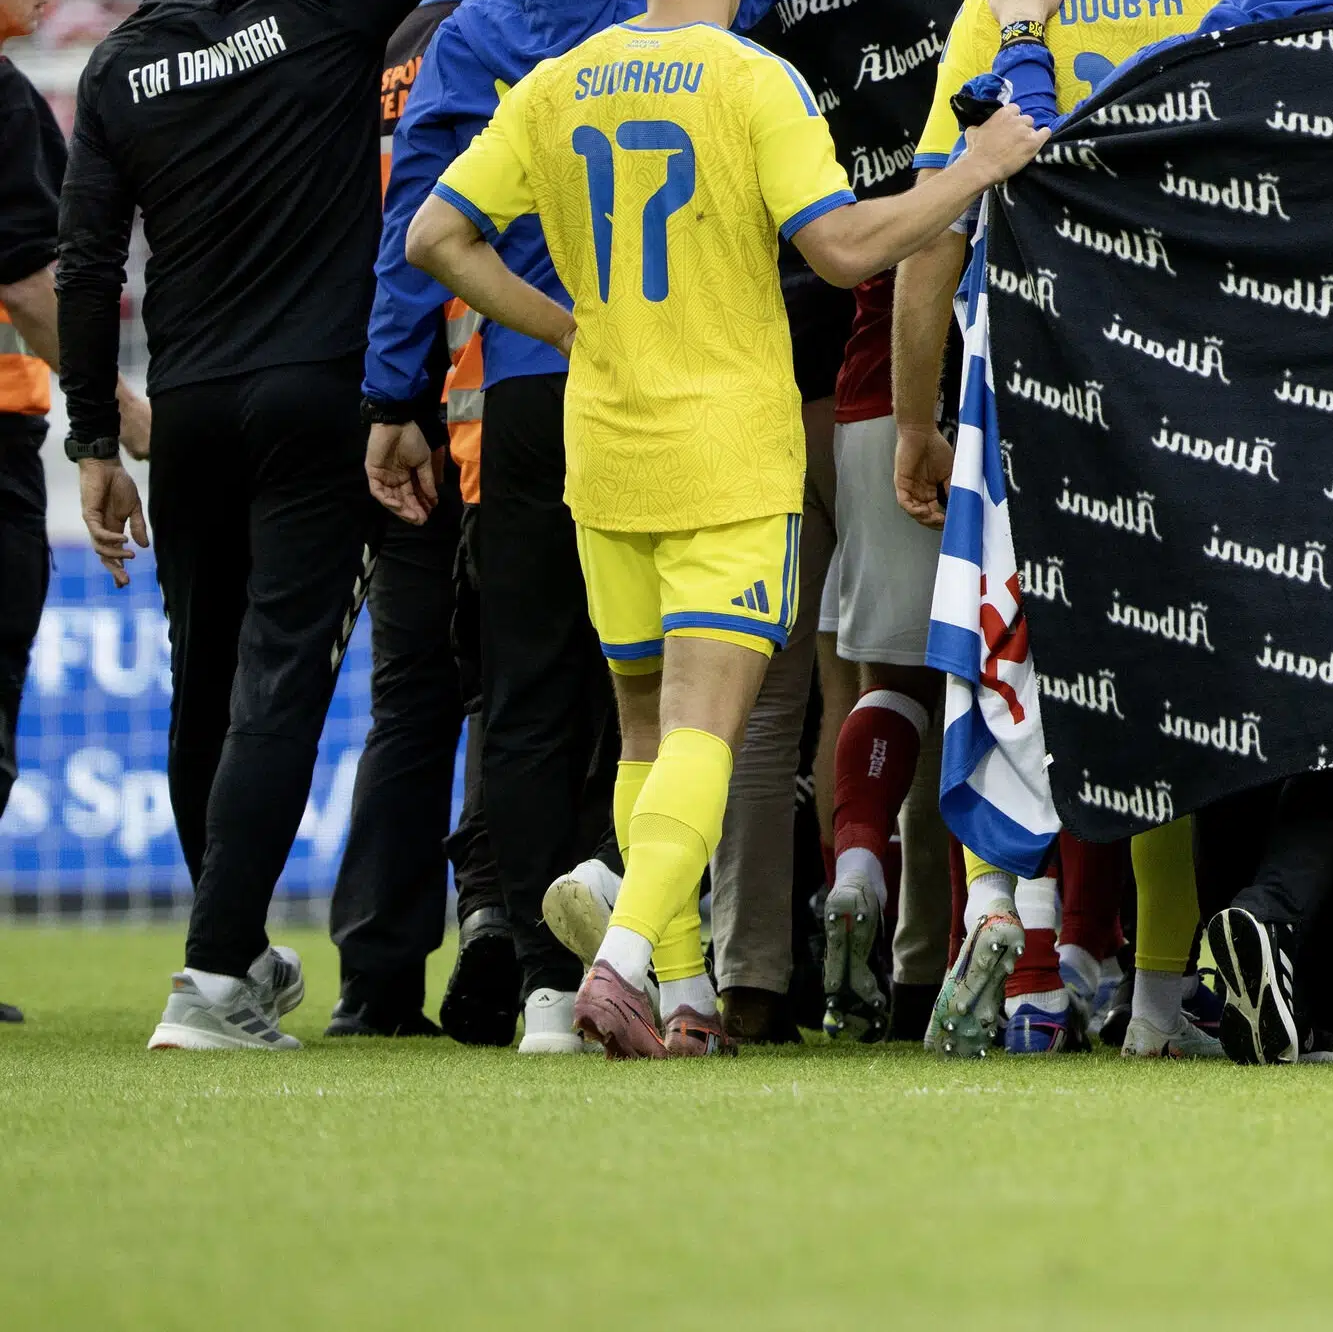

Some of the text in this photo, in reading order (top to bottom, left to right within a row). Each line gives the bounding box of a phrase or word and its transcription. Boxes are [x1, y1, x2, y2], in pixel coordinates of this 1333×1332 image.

[128, 15, 288, 104] FOR DANMARK
[574, 59, 704, 101] SUDAKOV
[572, 119, 696, 304] 17
